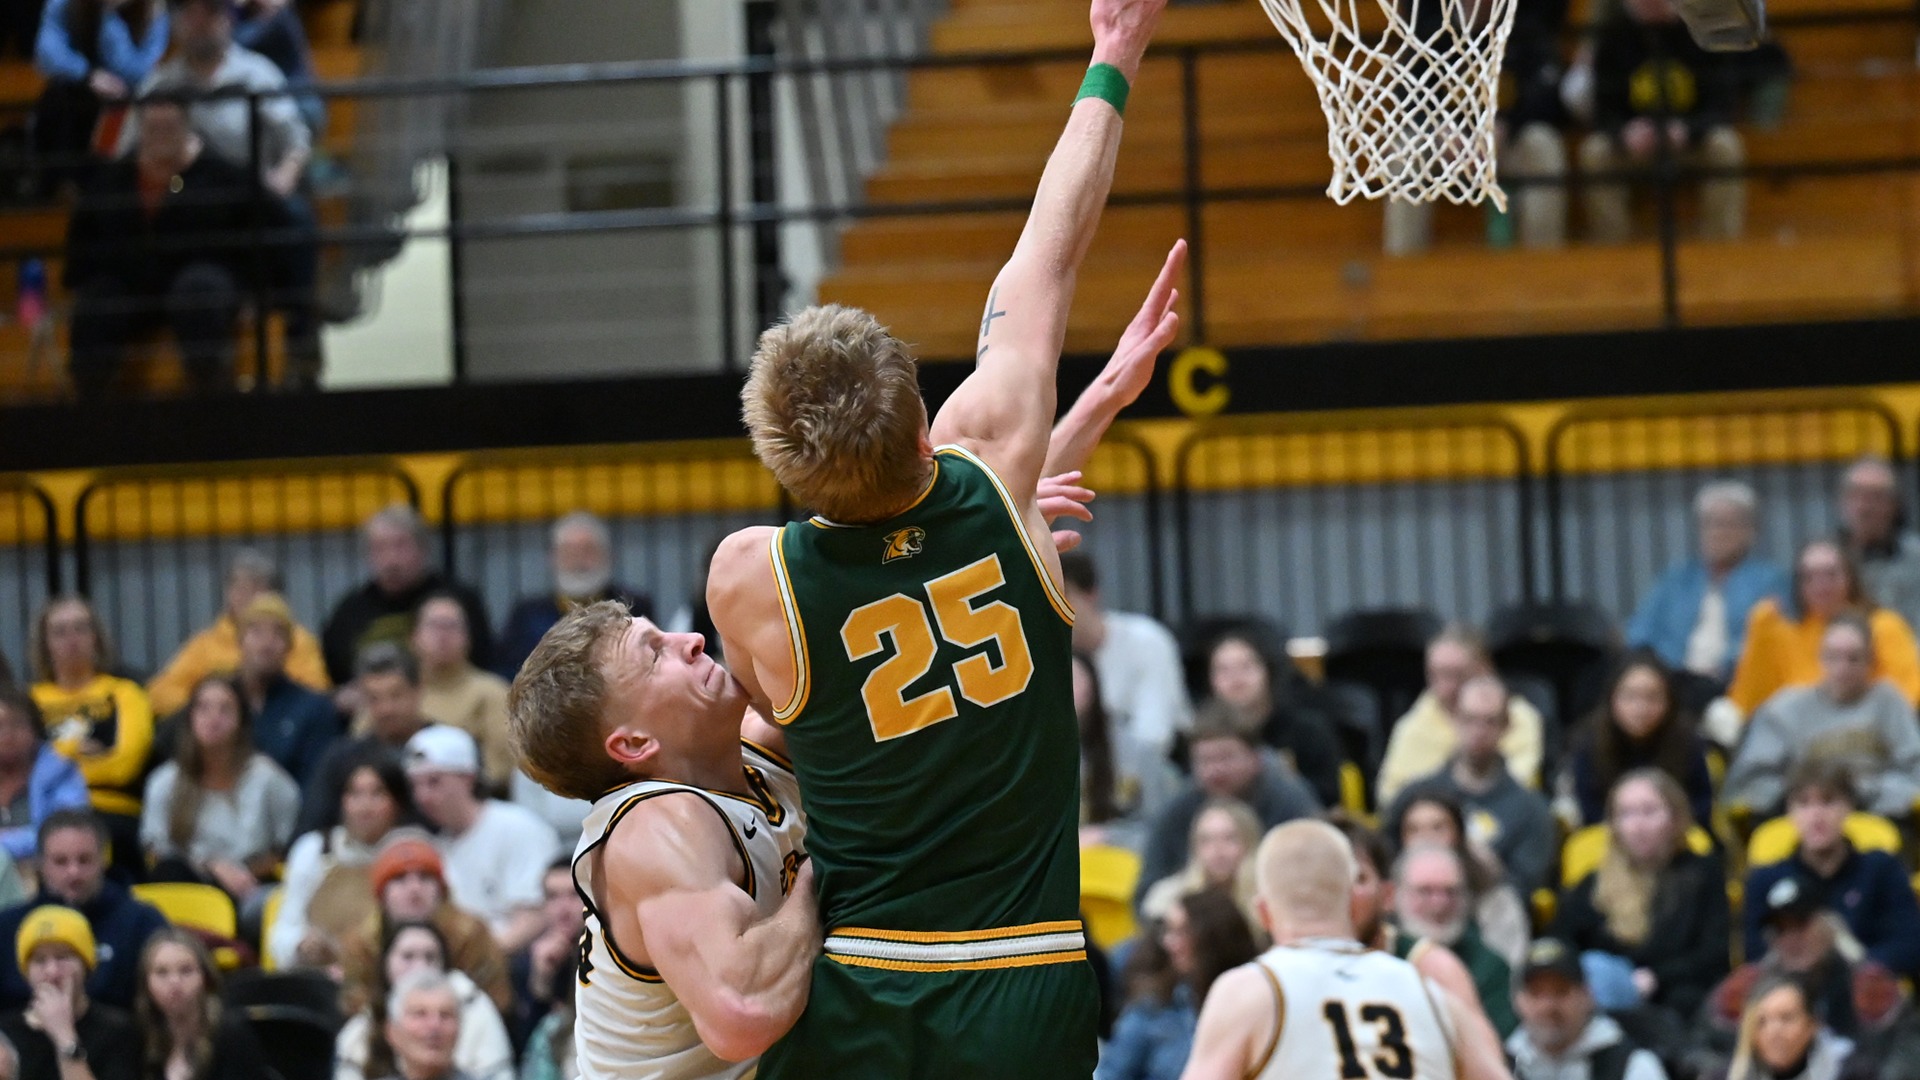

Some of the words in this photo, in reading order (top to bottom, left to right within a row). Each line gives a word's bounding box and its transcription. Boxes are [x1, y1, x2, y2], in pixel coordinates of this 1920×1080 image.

[1169, 347, 1231, 414] C
[840, 552, 1035, 743] 25
[1321, 1000, 1415, 1080] 13
